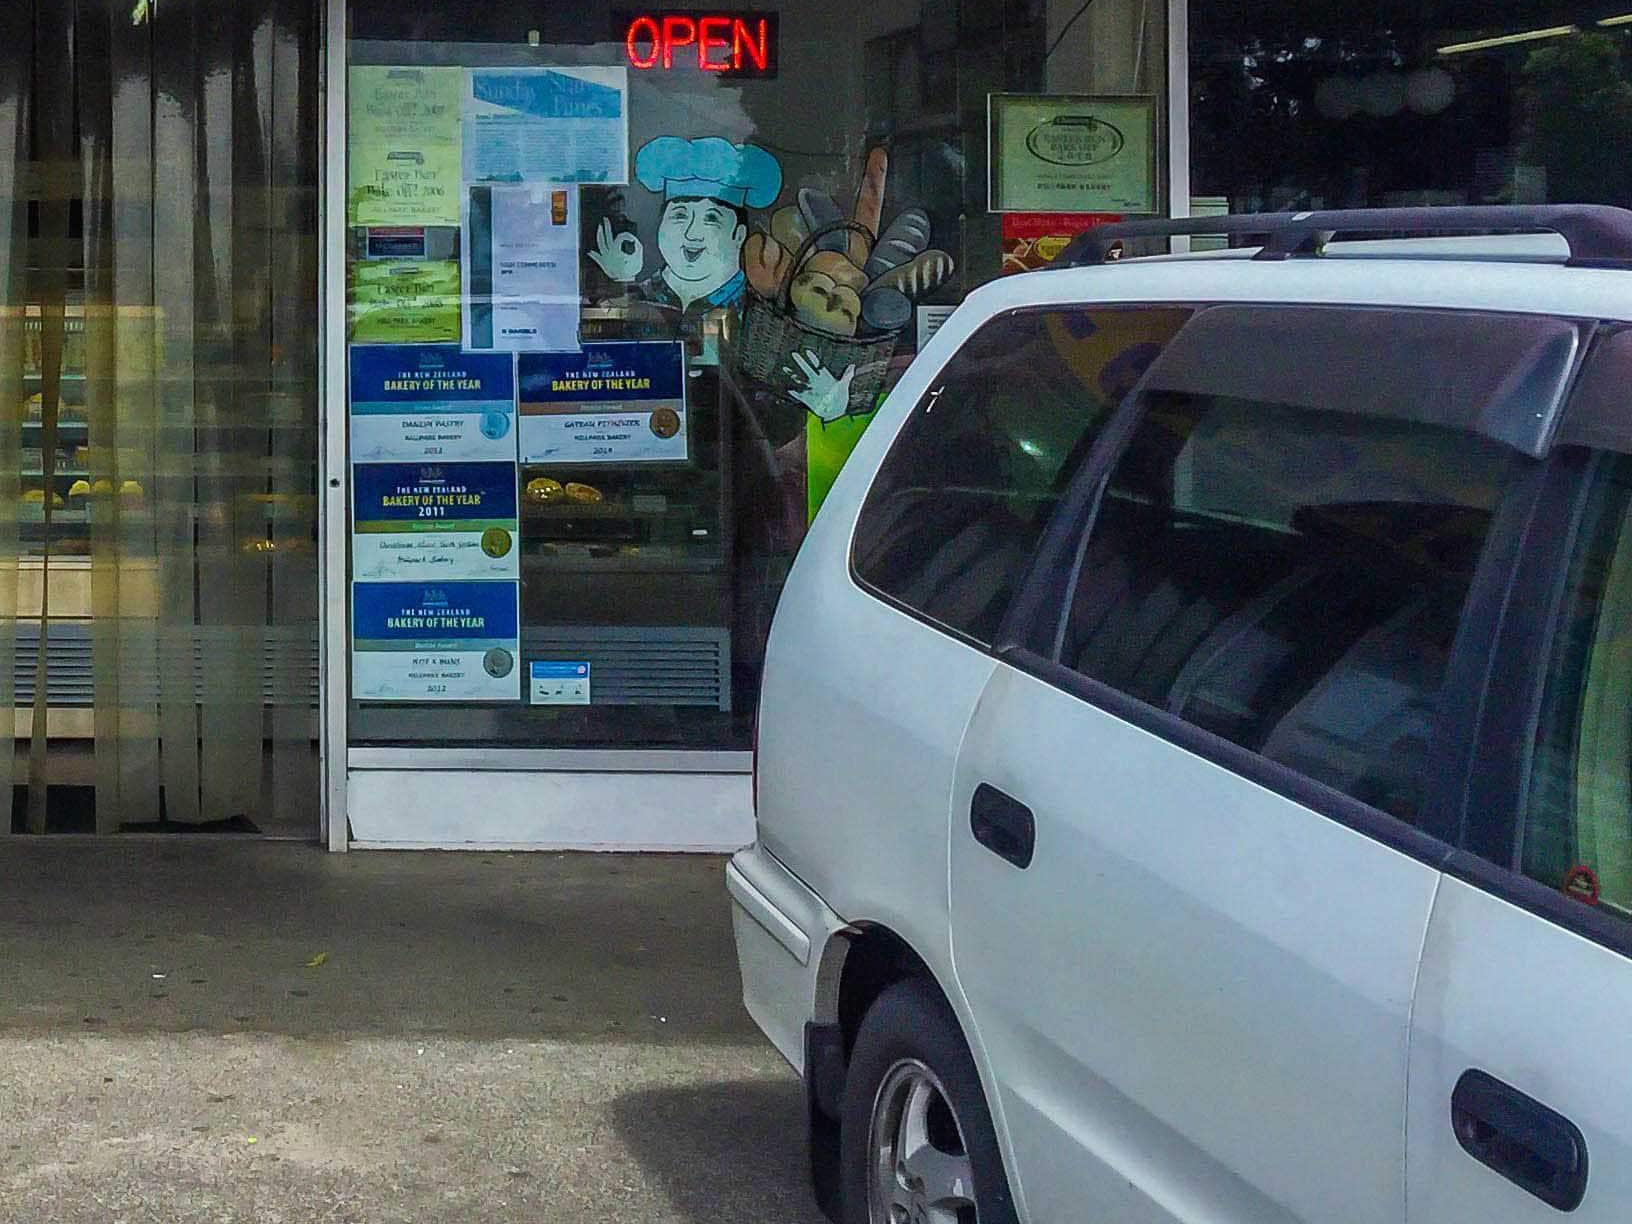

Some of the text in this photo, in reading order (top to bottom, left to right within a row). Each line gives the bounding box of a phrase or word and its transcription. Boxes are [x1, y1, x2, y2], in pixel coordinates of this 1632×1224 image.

[627, 16, 766, 71] OPEN
[384, 379, 481, 391] BAKERY OF THE YEAR
[551, 378, 650, 392] BAKERY OF THE YEAR
[382, 495, 481, 506] BAKERY OF THE YEAR
[418, 506, 445, 517] 2011
[387, 617, 485, 628] BAKERY OF THE YEAR
